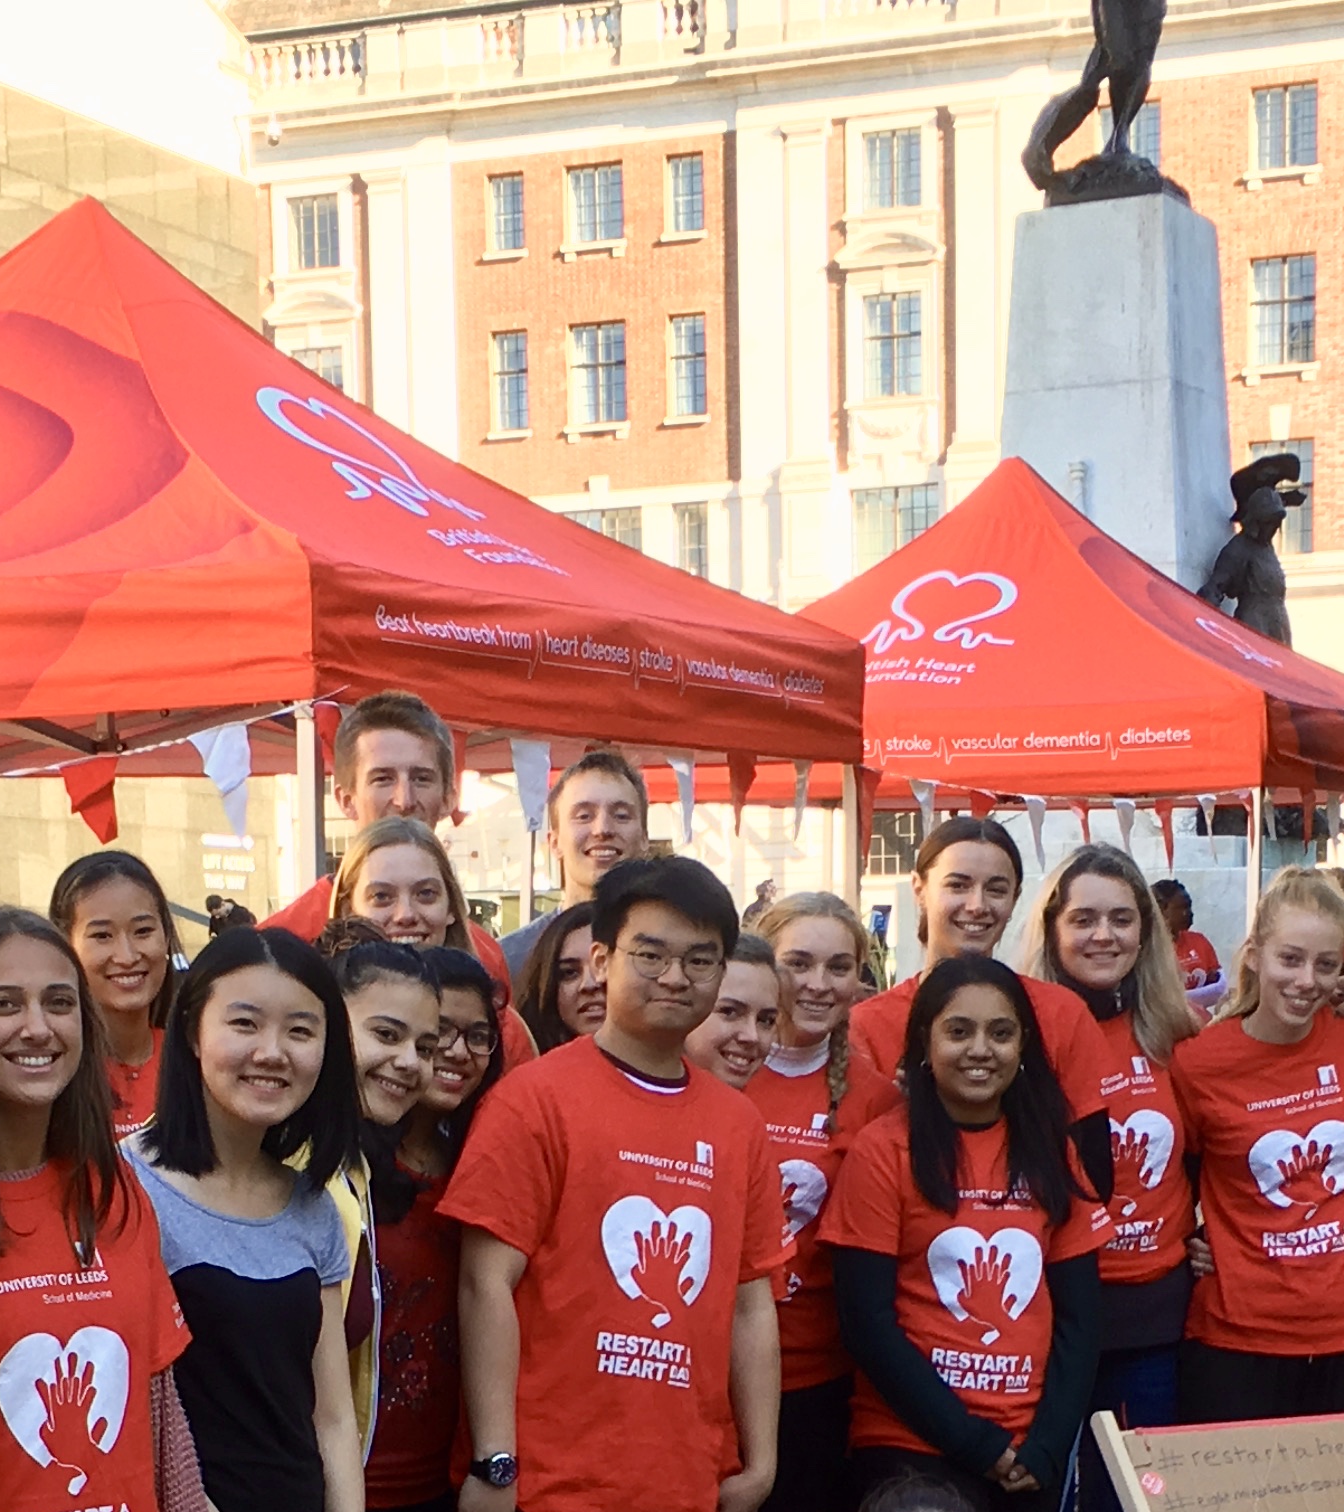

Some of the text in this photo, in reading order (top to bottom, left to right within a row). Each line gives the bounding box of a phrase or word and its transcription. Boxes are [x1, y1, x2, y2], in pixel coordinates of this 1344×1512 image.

[375, 605, 824, 694] Beat heartbreak from heart diseases stroke vascular dementia diabetes
[915, 656, 976, 674] Heart
[886, 734, 932, 751] stroke
[951, 733, 1017, 750] vascular
[1023, 731, 1101, 748] dementia
[1119, 727, 1191, 745] diabetes
[1246, 1084, 1341, 1112] UNIVERSITY OF LEEDS
[787, 1125, 801, 1136] OF
[618, 1150, 714, 1179] UNIVERSITY OF LEEDS
[1262, 1220, 1341, 1248] RESTART
[1268, 1239, 1330, 1257] HEART
[58, 1272, 73, 1286] OF
[75, 1269, 109, 1285] LEEDS
[596, 1331, 685, 1363] RESTART
[931, 1347, 1032, 1373] RESTART A
[597, 1353, 669, 1382] HEART
[936, 1367, 1030, 1391] HEART DAY
